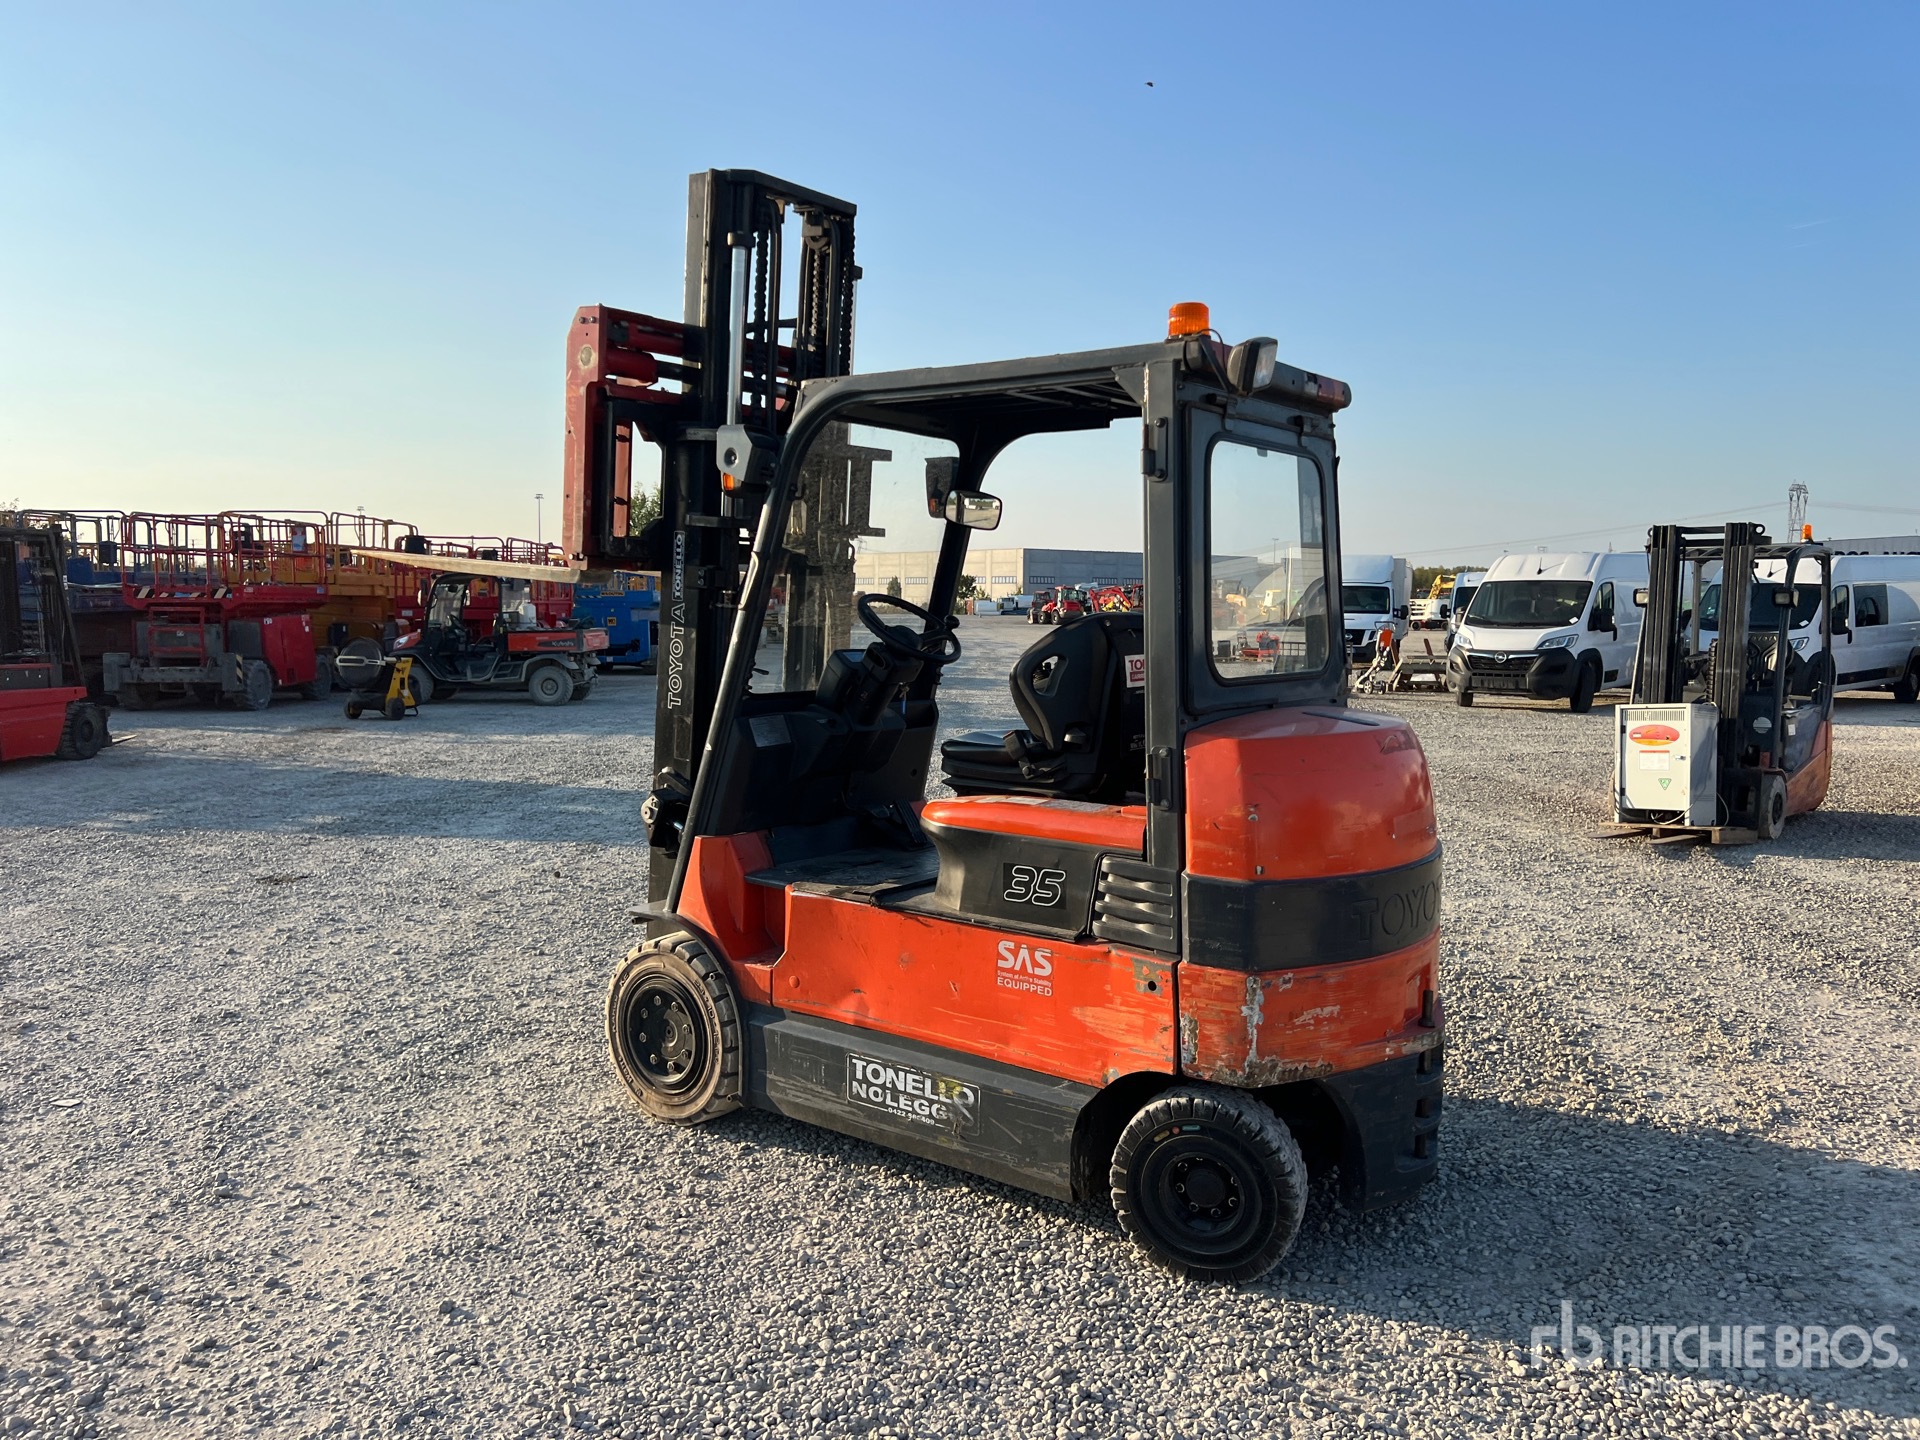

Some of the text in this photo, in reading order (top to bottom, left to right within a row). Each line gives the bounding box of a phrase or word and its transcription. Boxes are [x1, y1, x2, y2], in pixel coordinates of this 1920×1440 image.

[674, 533, 684, 599] TONELLO
[667, 602, 686, 709] TOYOTA
[1004, 865, 1066, 906] 35
[1351, 879, 1441, 941] TOYO
[997, 940, 1053, 977] SAS
[997, 977, 1053, 997] EQUIPPED
